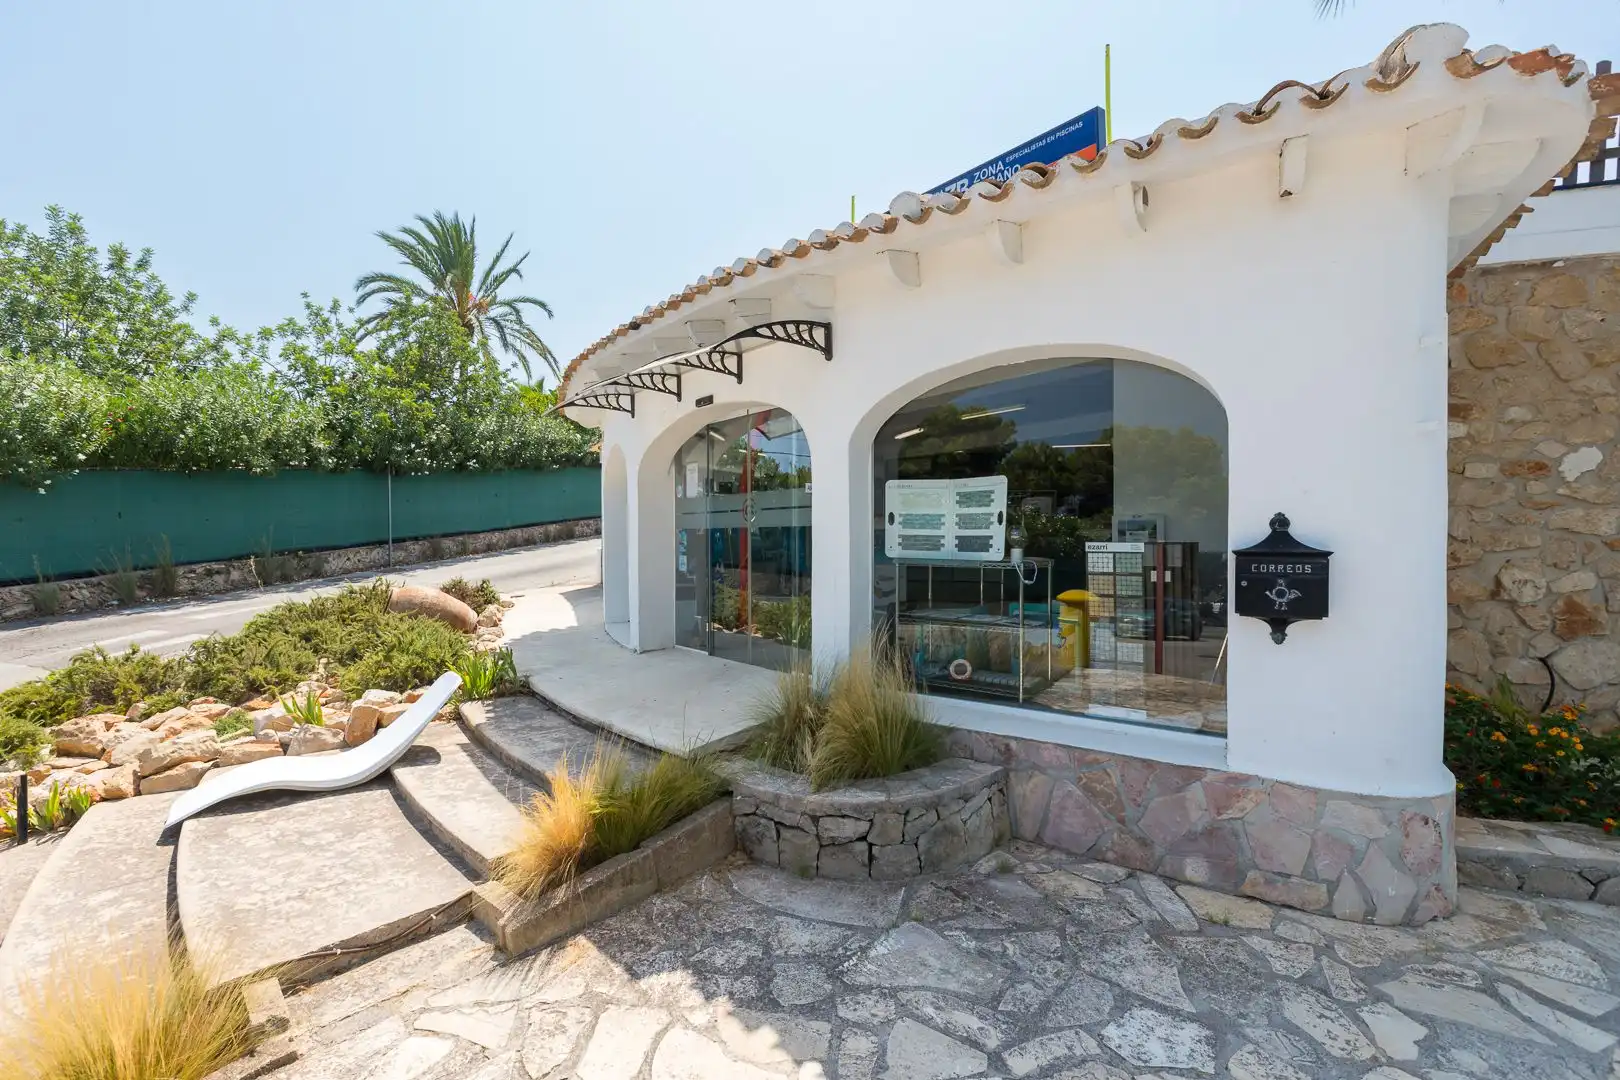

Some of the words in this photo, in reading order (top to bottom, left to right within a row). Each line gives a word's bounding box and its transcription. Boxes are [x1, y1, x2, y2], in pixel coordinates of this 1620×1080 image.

[1005, 139, 1046, 162] ESPECIALISTAS
[1047, 133, 1055, 143] EN
[1056, 121, 1083, 140] PISCINAS
[973, 160, 1005, 183] ZONA
[1251, 563, 1312, 573] CORREOS
